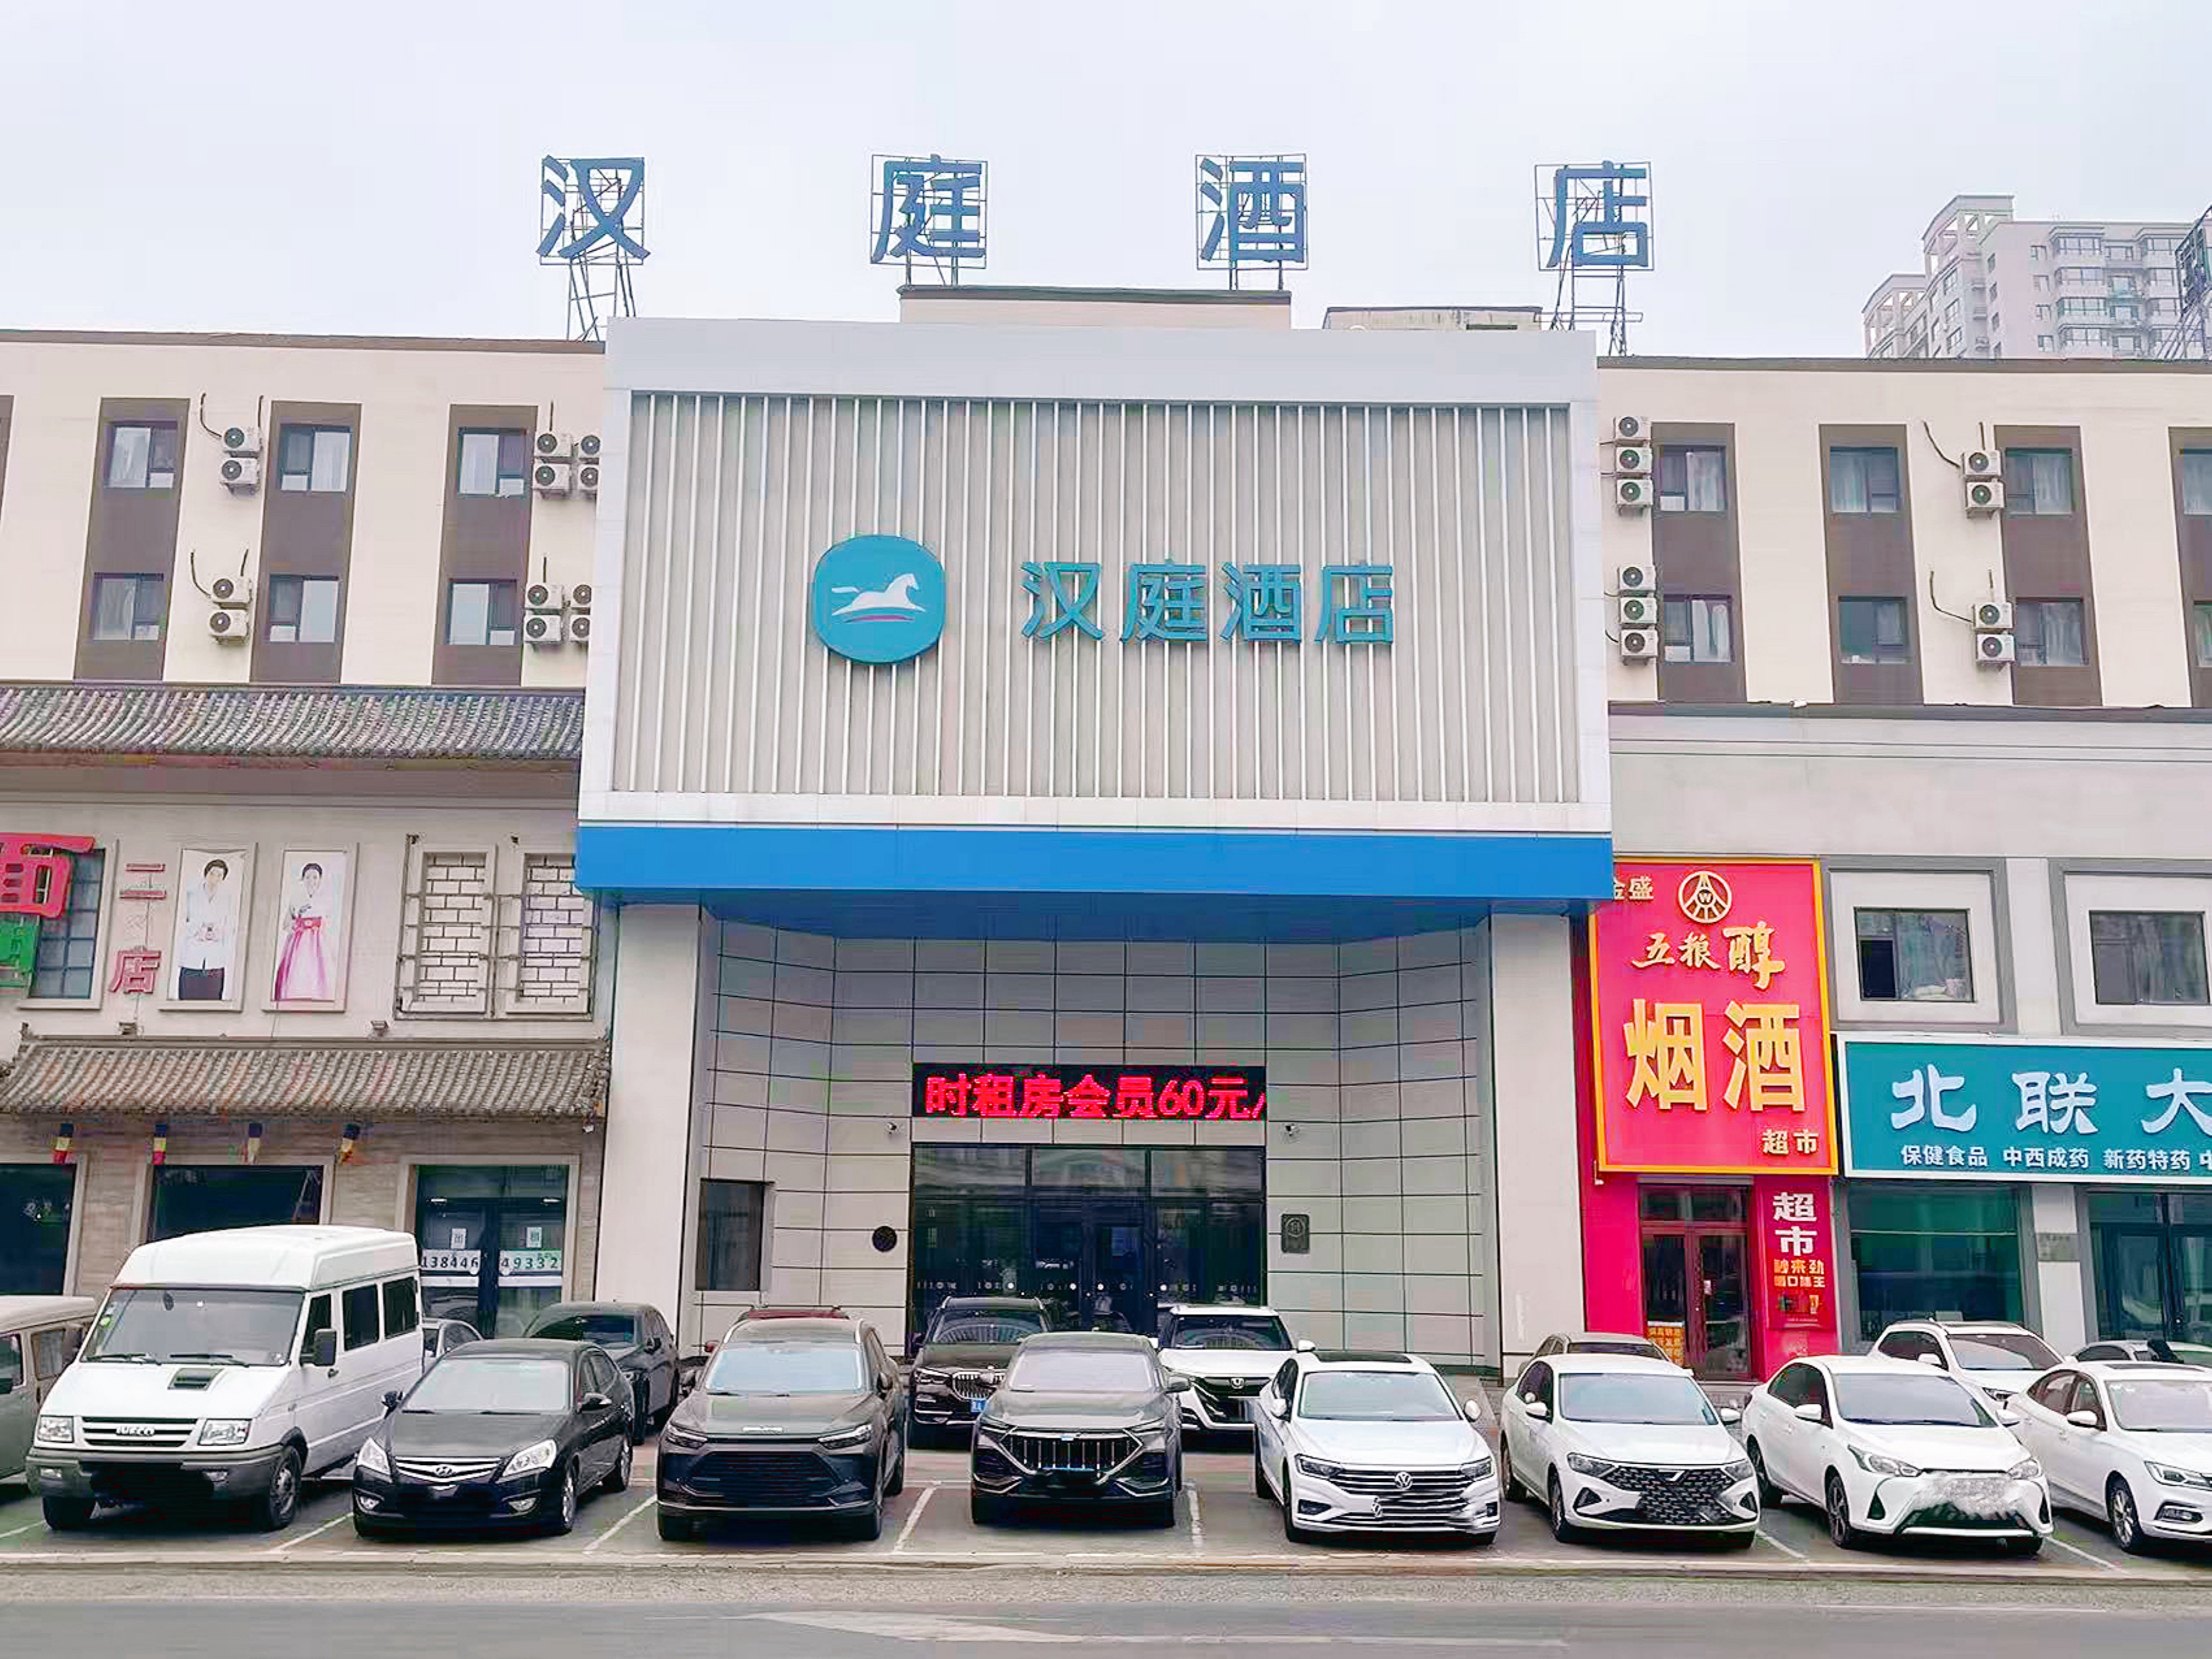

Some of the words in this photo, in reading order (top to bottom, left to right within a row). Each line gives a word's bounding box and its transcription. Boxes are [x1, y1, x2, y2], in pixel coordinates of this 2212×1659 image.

[538, 155, 1647, 270] 汉庭酒店
[1019, 559, 1394, 646] 汉庭酒店
[110, 862, 166, 994] 二店
[1632, 921, 1786, 990] 五粮醇
[1623, 998, 1805, 1111] 烟酒
[1891, 1064, 2212, 1135] 北联大
[1762, 1128, 1819, 1155] 超市
[1900, 1144, 1988, 1168] 保健食品
[2003, 1147, 2089, 1169] 中西成药
[2102, 1148, 2191, 1171] 新药特药
[1773, 1192, 1818, 1257] 超市
[421, 1256, 479, 1268] 138446
[501, 1257, 558, 1269] 49332
